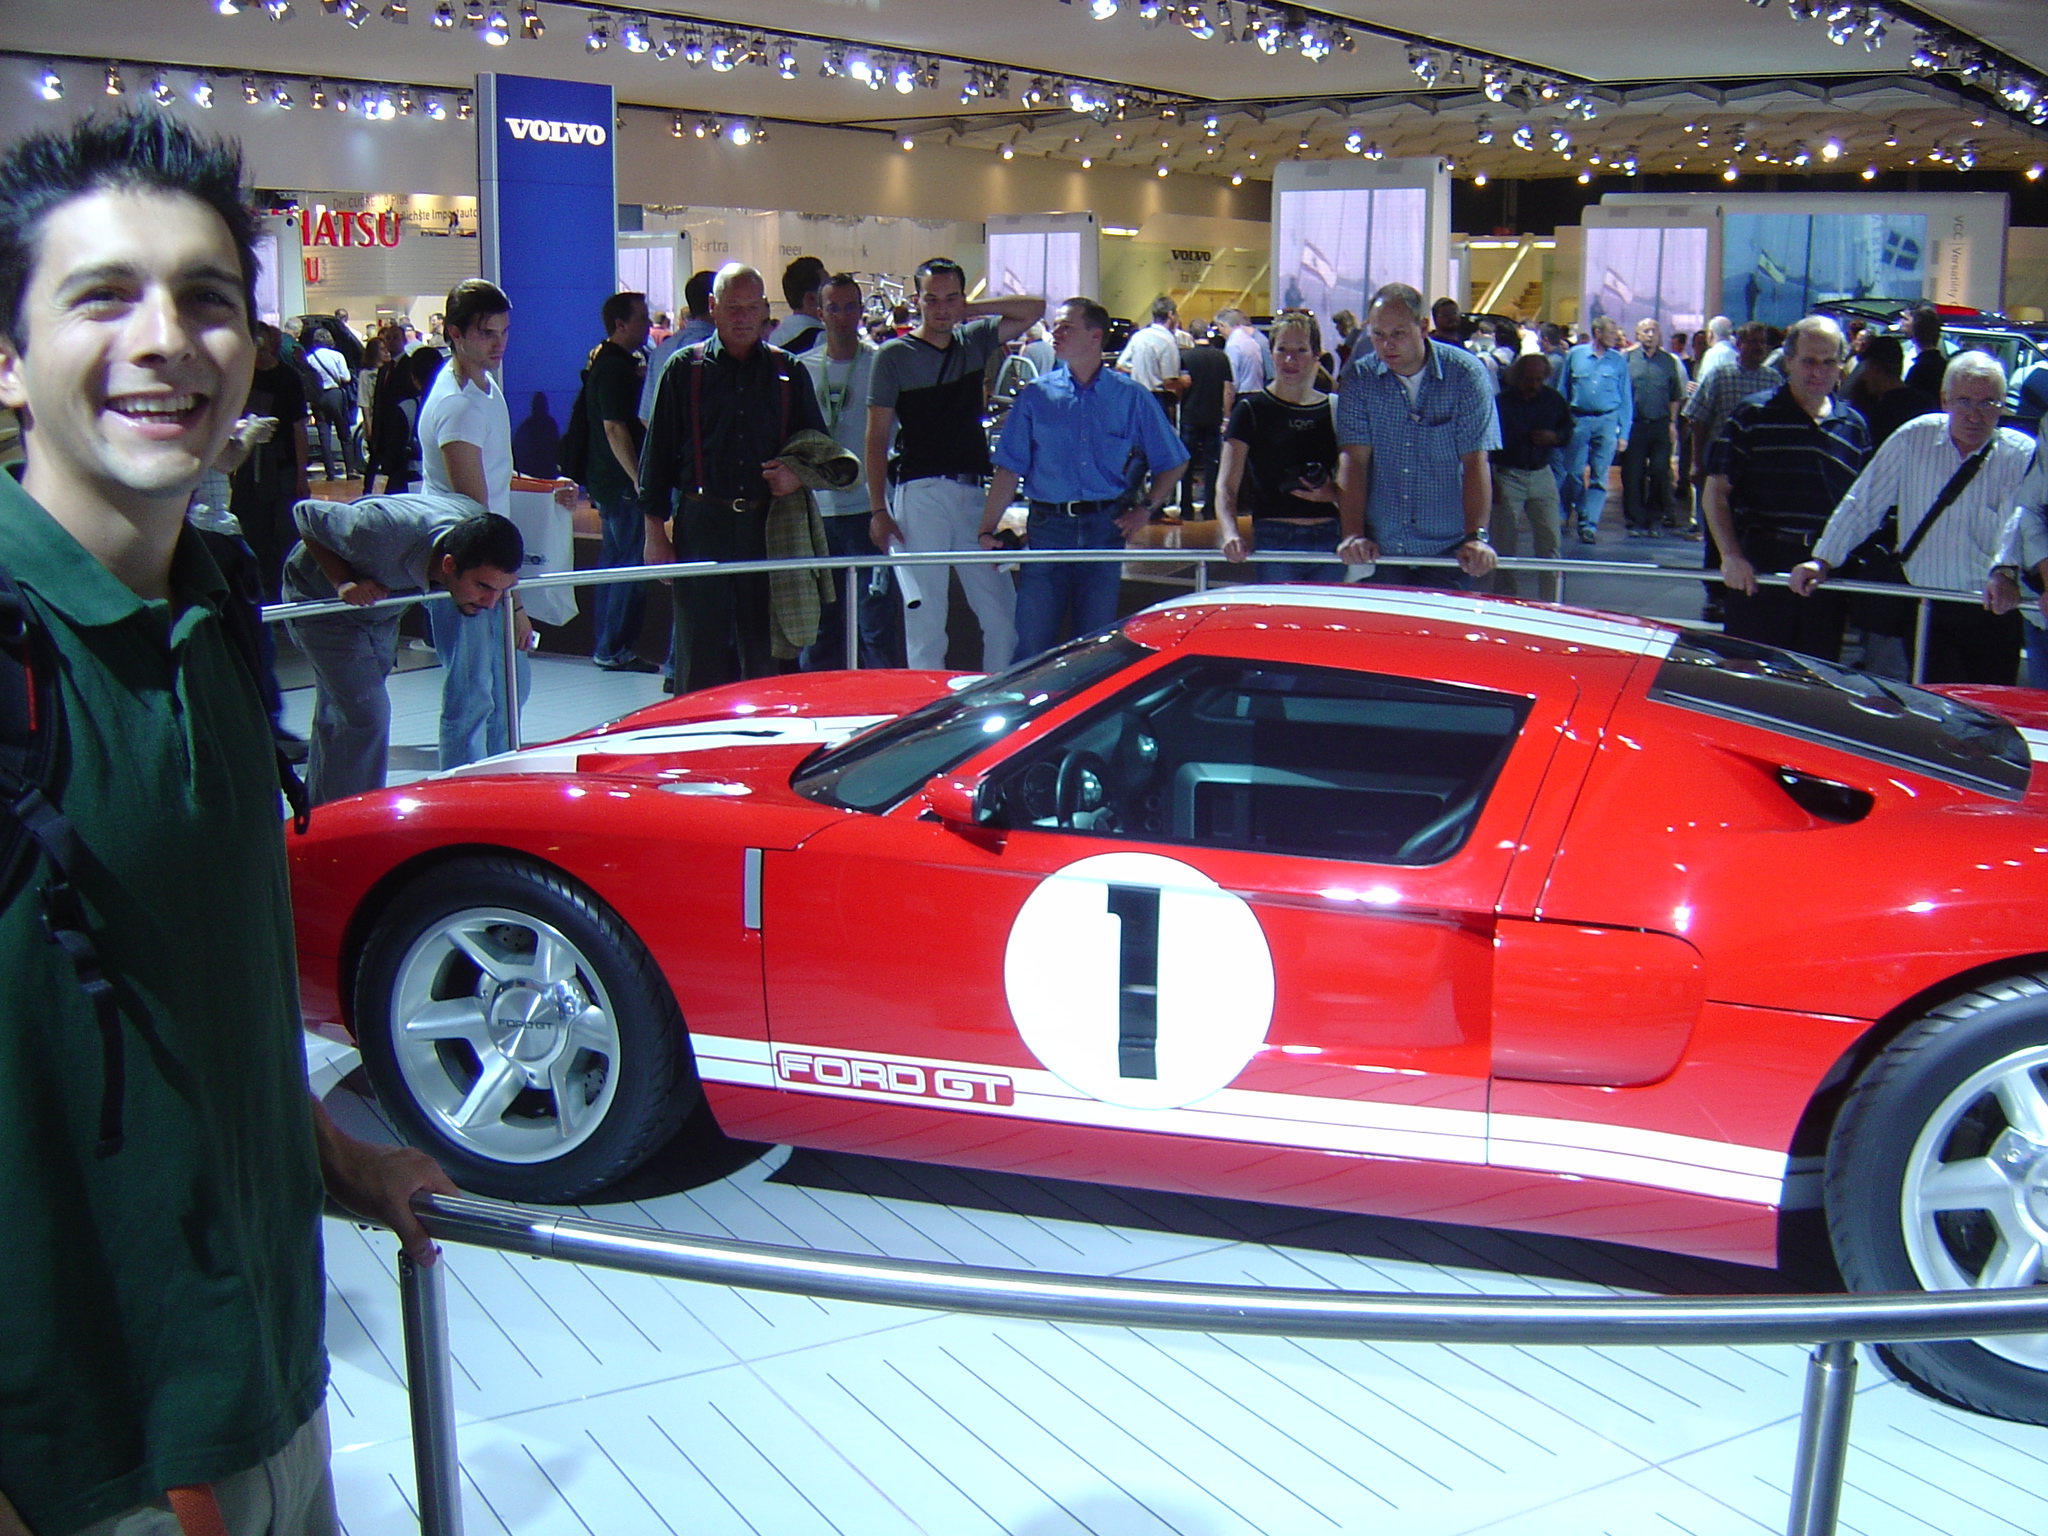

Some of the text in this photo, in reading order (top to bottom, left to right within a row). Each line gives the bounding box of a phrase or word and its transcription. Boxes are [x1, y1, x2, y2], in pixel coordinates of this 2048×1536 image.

[505, 118, 606, 146] VOLVO
[432, 207, 478, 223] Impotauto
[693, 237, 729, 254] Bertra
[1171, 249, 1211, 262] VOLVO
[1107, 883, 1161, 1080] 1
[498, 1019, 554, 1030] FORD GT
[779, 1052, 1010, 1103] FORD GT
